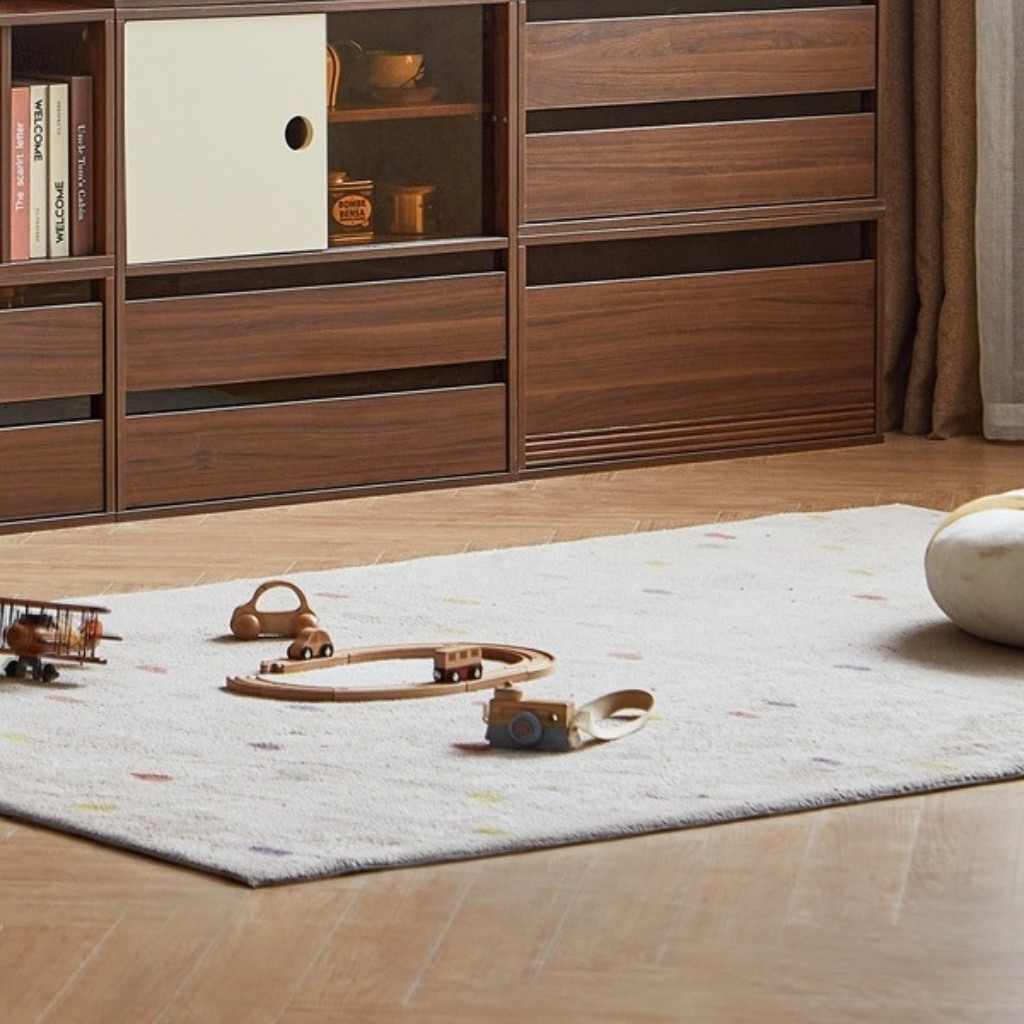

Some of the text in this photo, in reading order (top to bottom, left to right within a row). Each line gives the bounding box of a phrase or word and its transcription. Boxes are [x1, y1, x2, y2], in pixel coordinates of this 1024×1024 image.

[16, 122, 25, 149] letter
[34, 99, 44, 162] WELCOME
[77, 124, 86, 154] Uncle
[15, 191, 24, 212] The
[55, 180, 65, 244] WELCOME
[78, 189, 86, 221] Cabin
